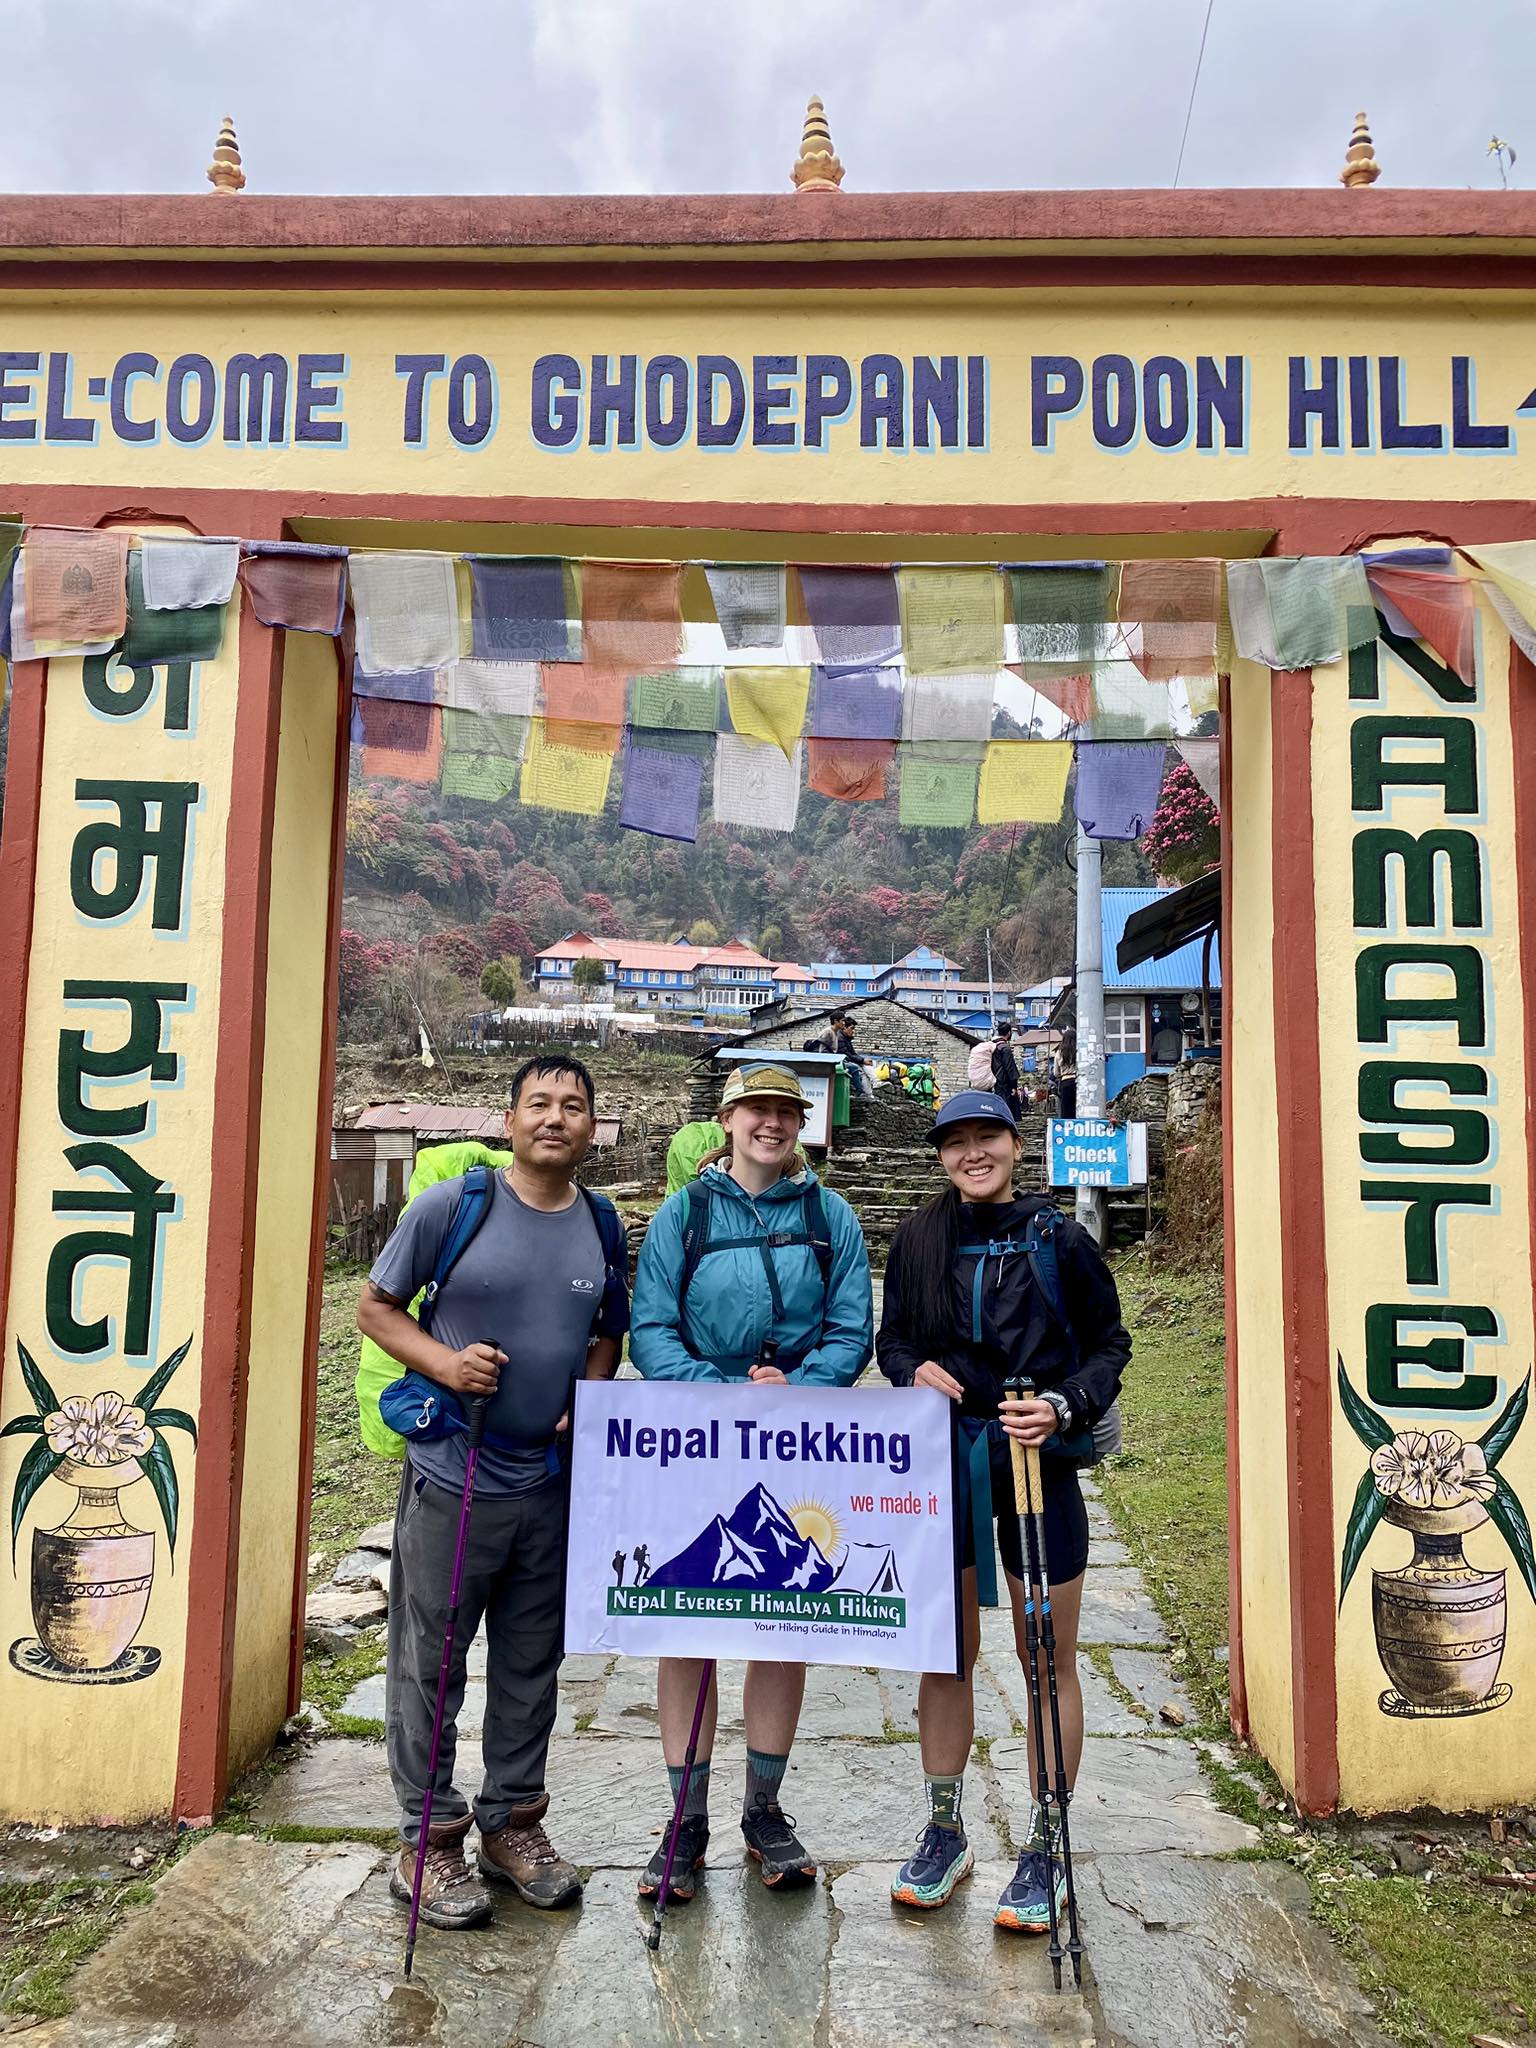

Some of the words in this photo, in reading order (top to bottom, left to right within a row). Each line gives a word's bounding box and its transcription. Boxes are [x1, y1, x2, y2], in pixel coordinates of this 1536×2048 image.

[395, 353, 496, 447] TO
[532, 354, 988, 449] GHODEPANI
[1031, 354, 1246, 450] POON
[1289, 355, 1514, 450] HILL
[1347, 606, 1498, 1412] NAMASTE
[1063, 1120, 1116, 1138] Police
[1064, 1145, 1117, 1163] Check
[1068, 1167, 1113, 1185] Point
[606, 1418, 719, 1467] Nepal
[734, 1420, 911, 1474] Trekking
[850, 1495, 874, 1512] we
[880, 1491, 921, 1514] made
[928, 1491, 938, 1515] it
[754, 1621, 776, 1632] Your
[778, 1622, 808, 1635] Hiking
[811, 1623, 839, 1635] Guide
[841, 1626, 850, 1635] in
[852, 1626, 897, 1640] Himalaya
